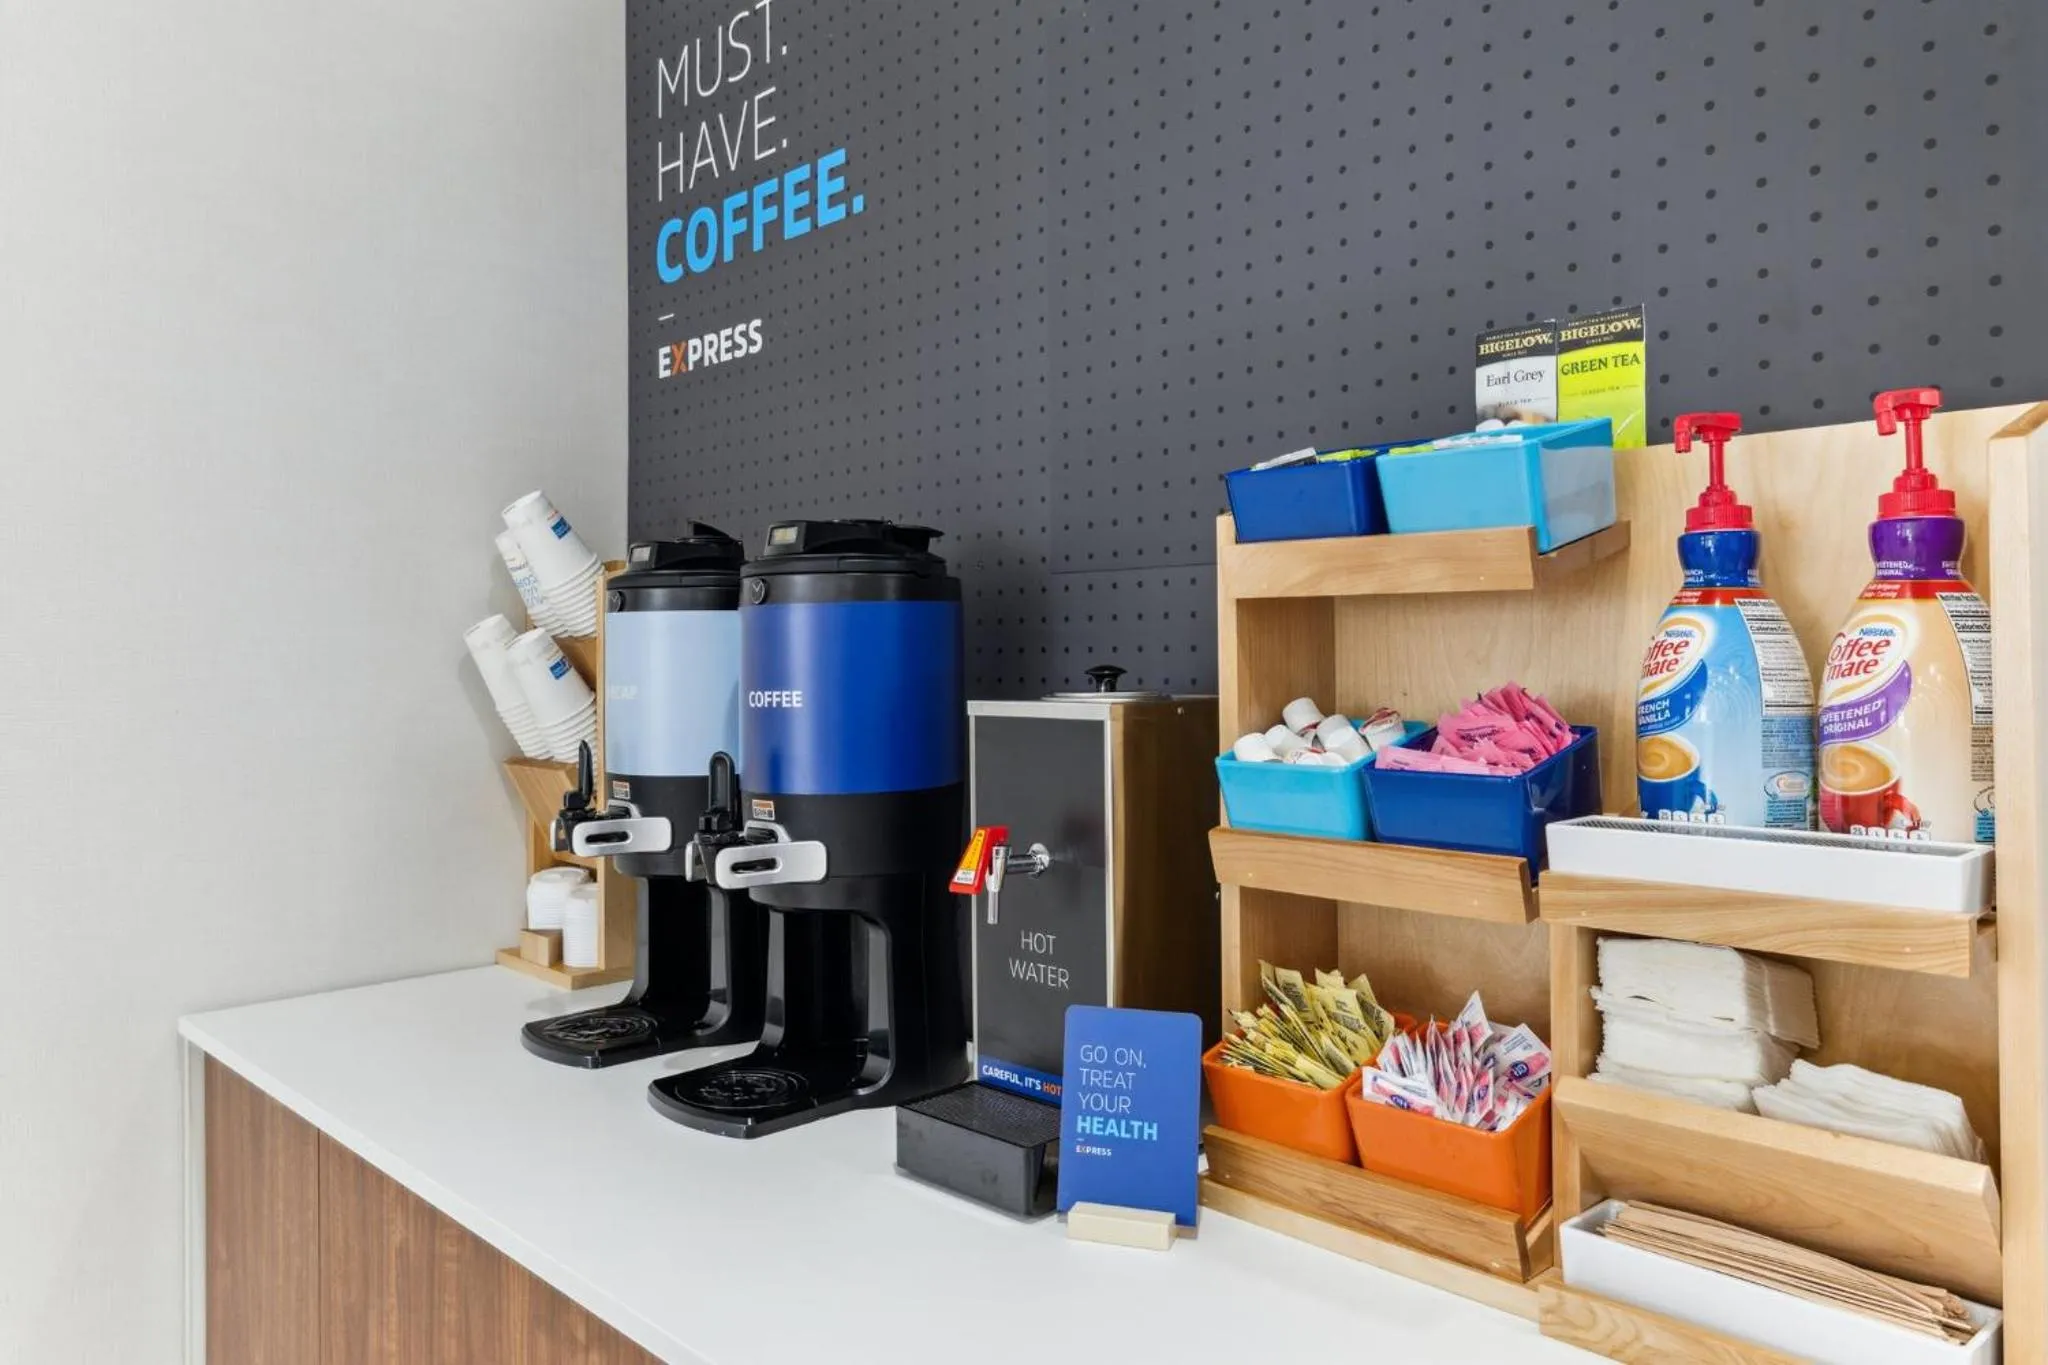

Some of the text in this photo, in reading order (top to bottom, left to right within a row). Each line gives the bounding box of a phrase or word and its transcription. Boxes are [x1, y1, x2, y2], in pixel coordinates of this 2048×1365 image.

[658, 0, 788, 119] MUST.
[658, 86, 788, 202] HAVE.
[656, 148, 864, 284] COFFEE.
[658, 318, 763, 379] EXPRESS
[1561, 353, 1641, 376] GREEN TEA
[1486, 369, 1546, 387] Earl Grey
[749, 690, 804, 708] COFFEE
[1020, 929, 1057, 955] HOT
[1009, 956, 1070, 989] WATER
[1080, 1045, 1147, 1069] GO ON,
[1024, 1076, 1041, 1091] IT'S
[1080, 1067, 1137, 1090] TREAT
[1077, 1092, 1132, 1114] YOUR
[1076, 1115, 1158, 1141] HEALTH
[1076, 1145, 1112, 1157] EXPRESS
